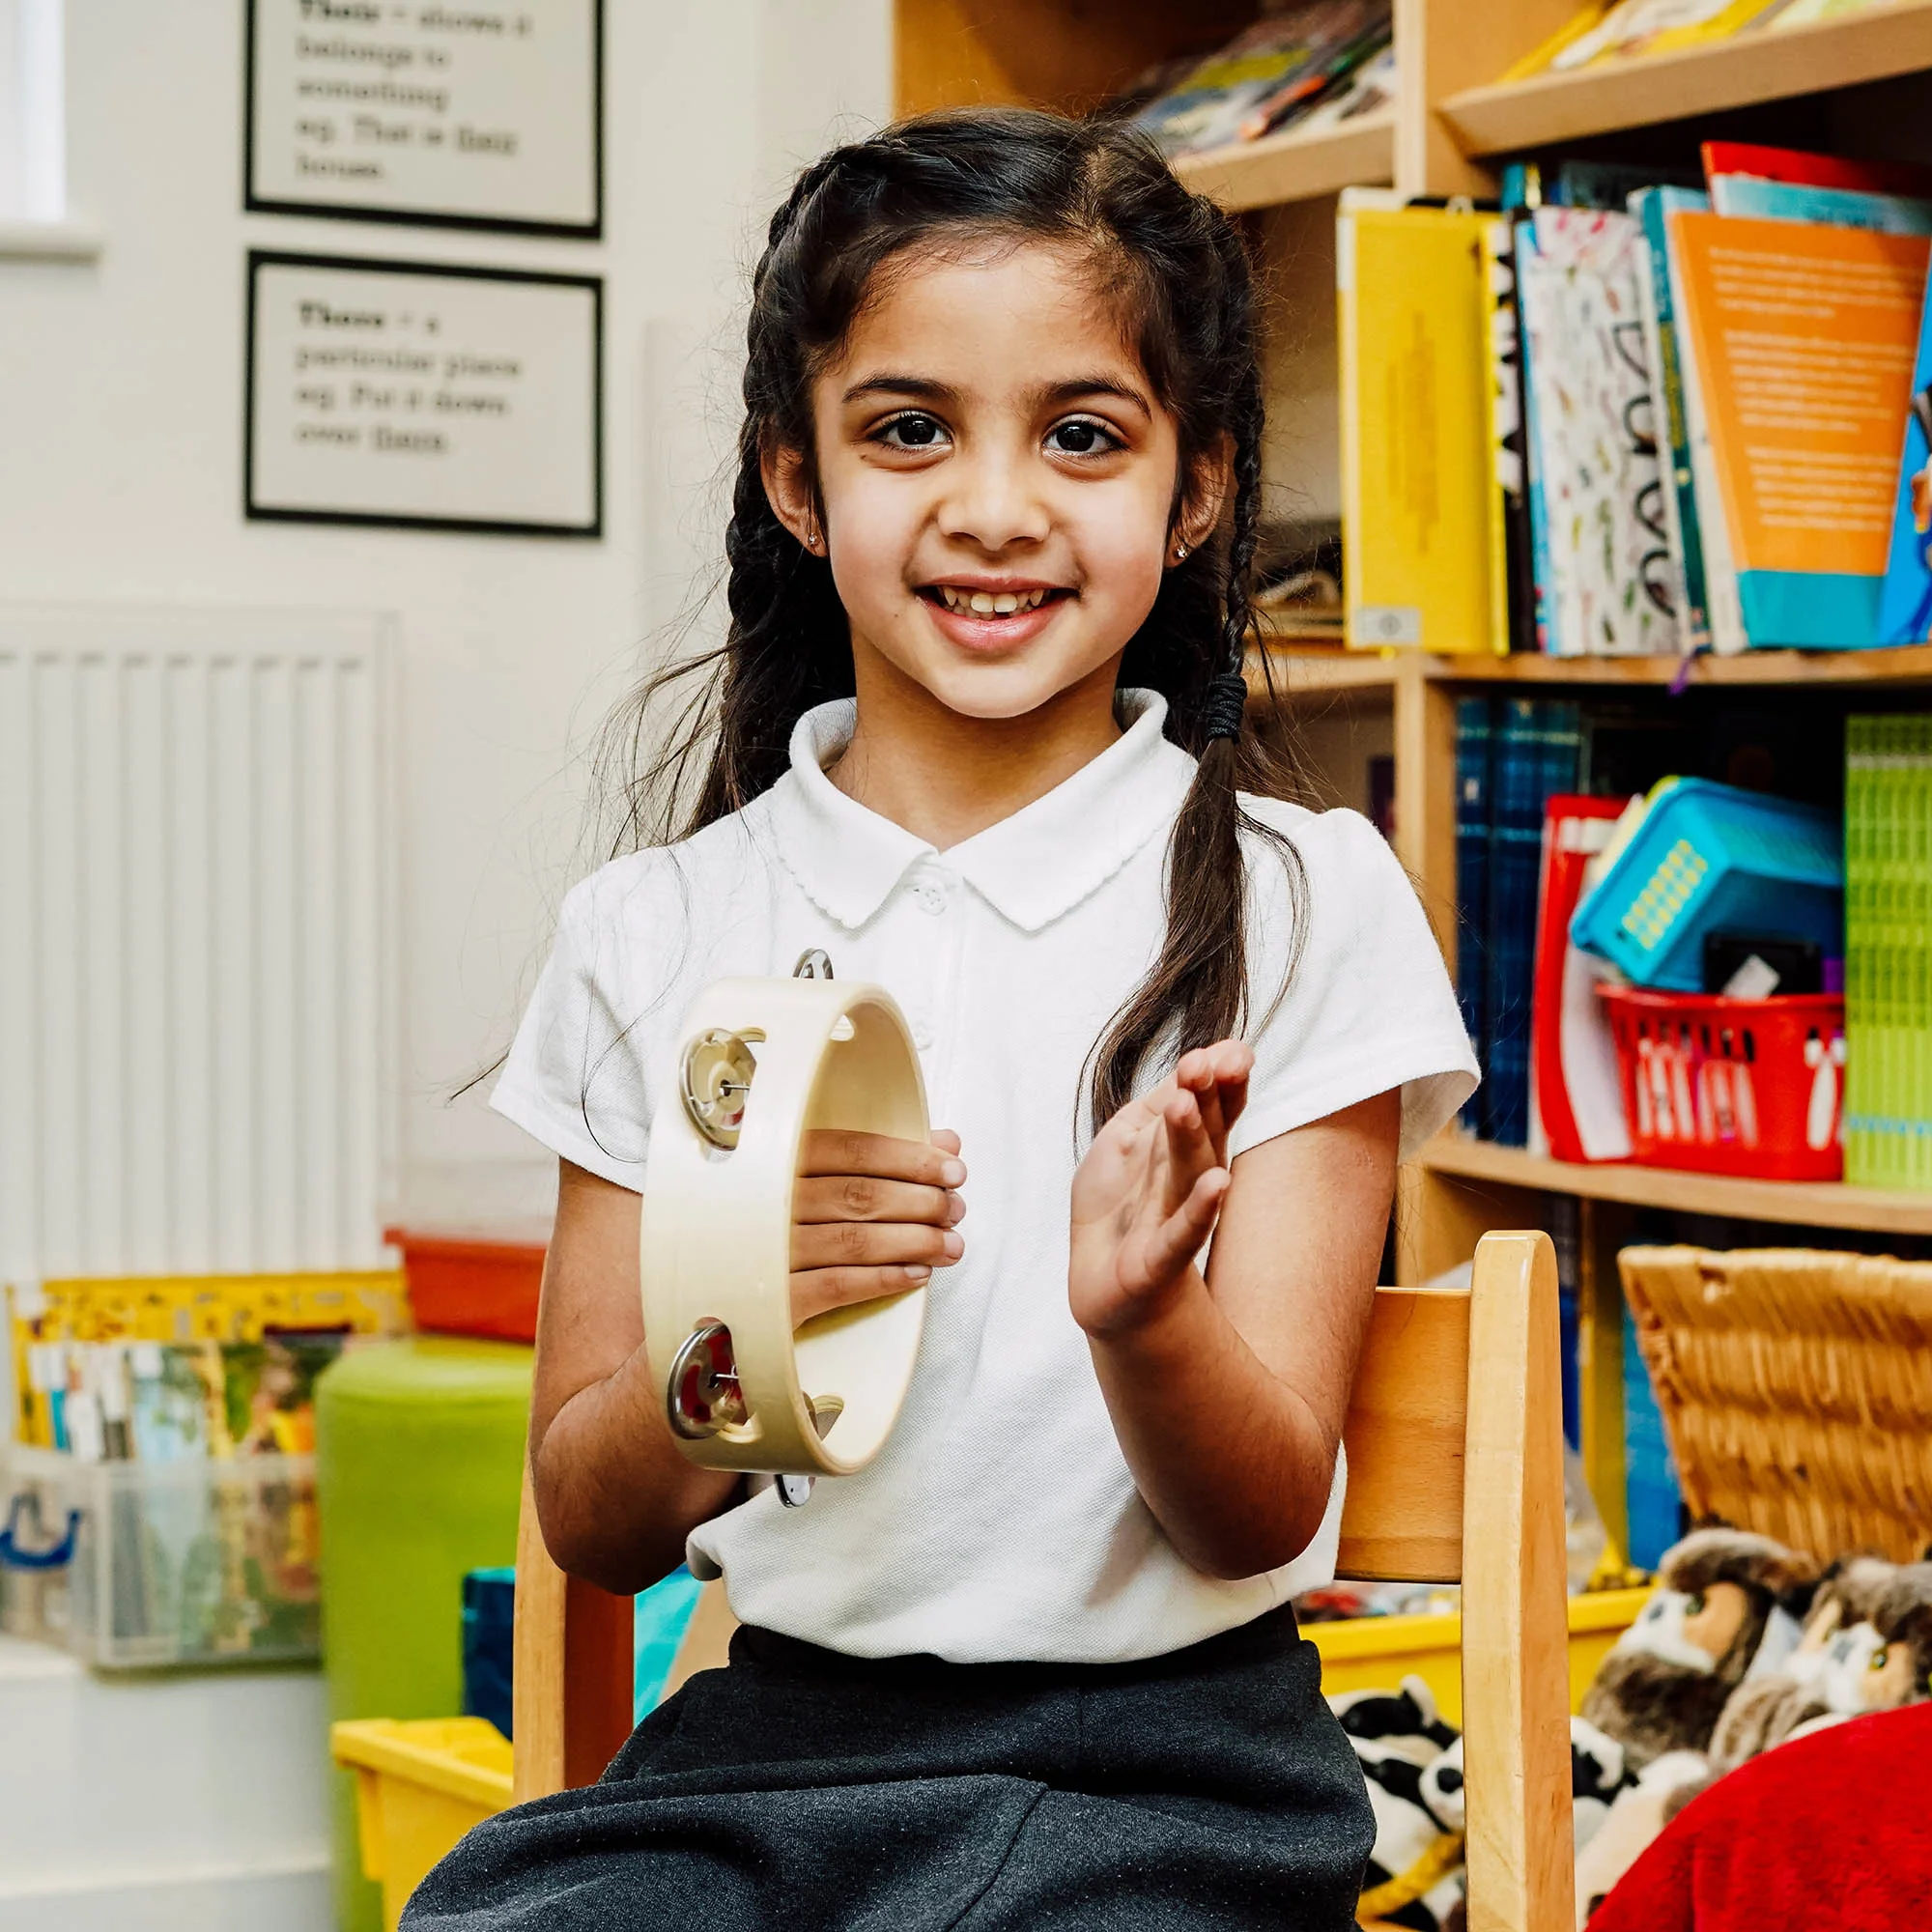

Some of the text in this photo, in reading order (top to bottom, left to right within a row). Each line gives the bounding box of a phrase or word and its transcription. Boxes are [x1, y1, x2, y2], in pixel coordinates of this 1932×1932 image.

[296, 35, 449, 70] belongs to
[296, 78, 448, 113] something
[297, 299, 384, 328] There
[296, 345, 523, 382] particular place
[351, 383, 394, 410] Put
[431, 389, 508, 415] down
[296, 424, 358, 445] over
